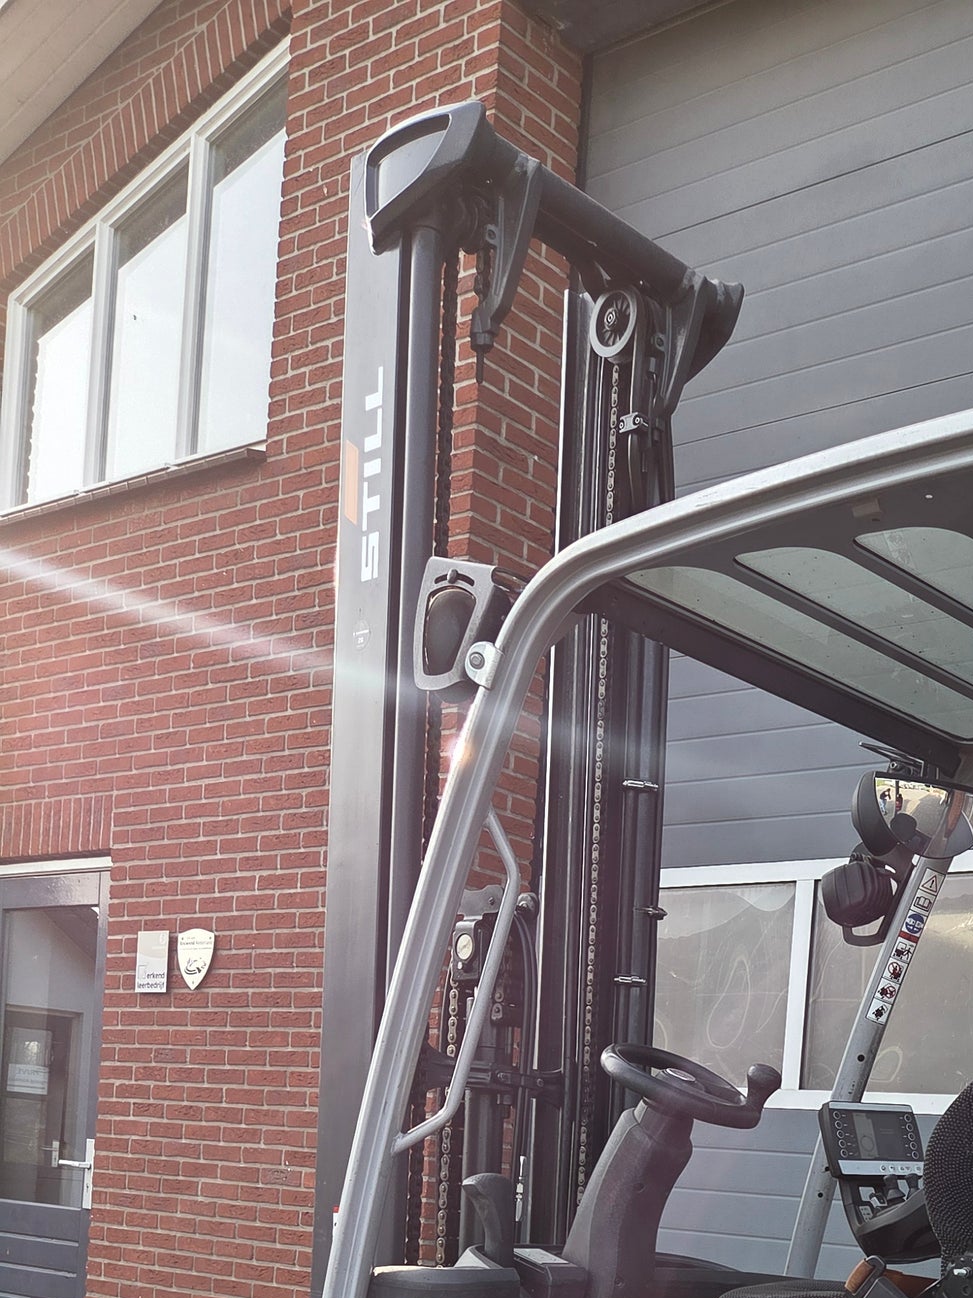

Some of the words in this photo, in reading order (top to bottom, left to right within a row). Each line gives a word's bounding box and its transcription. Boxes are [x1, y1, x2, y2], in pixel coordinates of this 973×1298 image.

[361, 366, 384, 582] STILL
[146, 971, 165, 979] erkend
[137, 981, 165, 990] leerbedrijf
